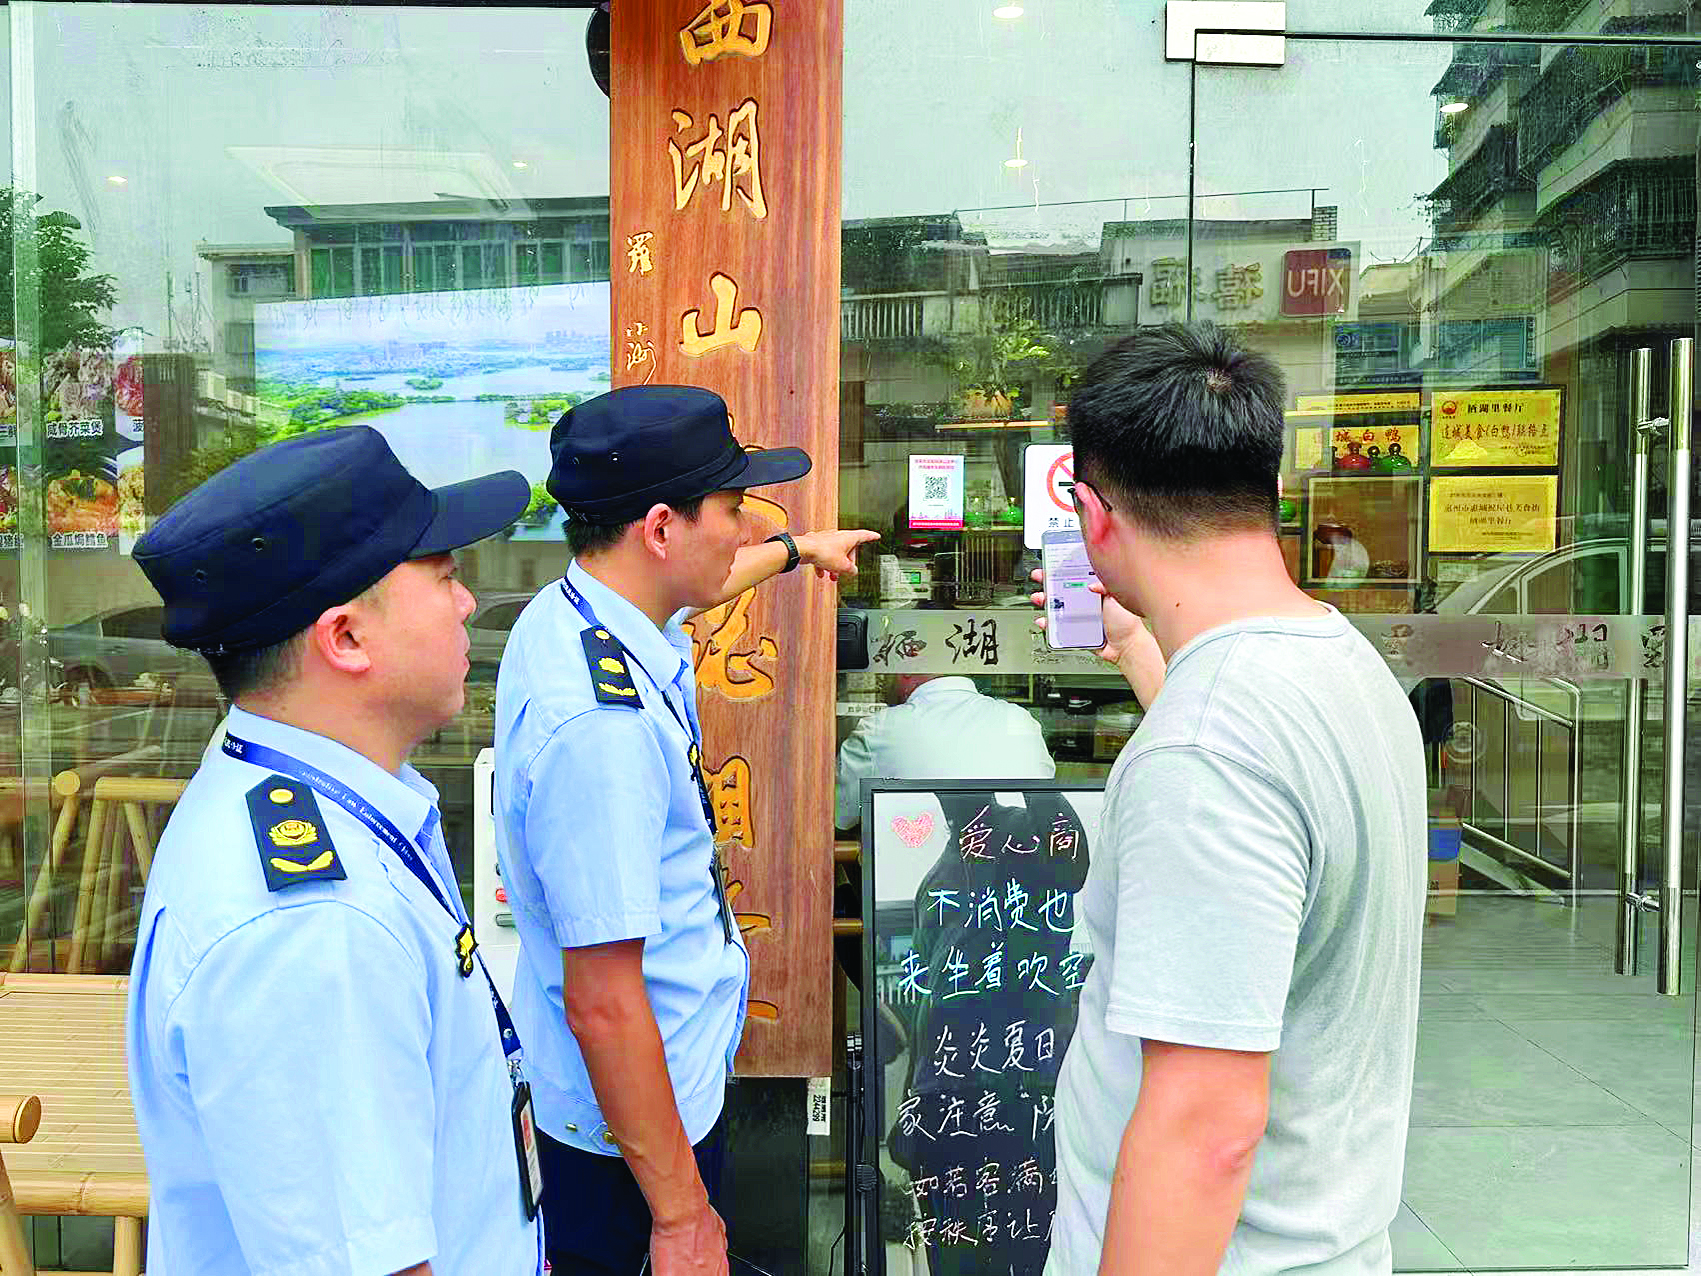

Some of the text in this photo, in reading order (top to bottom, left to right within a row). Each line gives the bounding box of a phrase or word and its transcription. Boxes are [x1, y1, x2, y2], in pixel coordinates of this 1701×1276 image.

[958, 804, 1079, 860] 爱心商
[926, 877, 1085, 933] 不消费也
[933, 1019, 1055, 1078] 炎炎夏日
[902, 1205, 1056, 1250] 按秩序让
